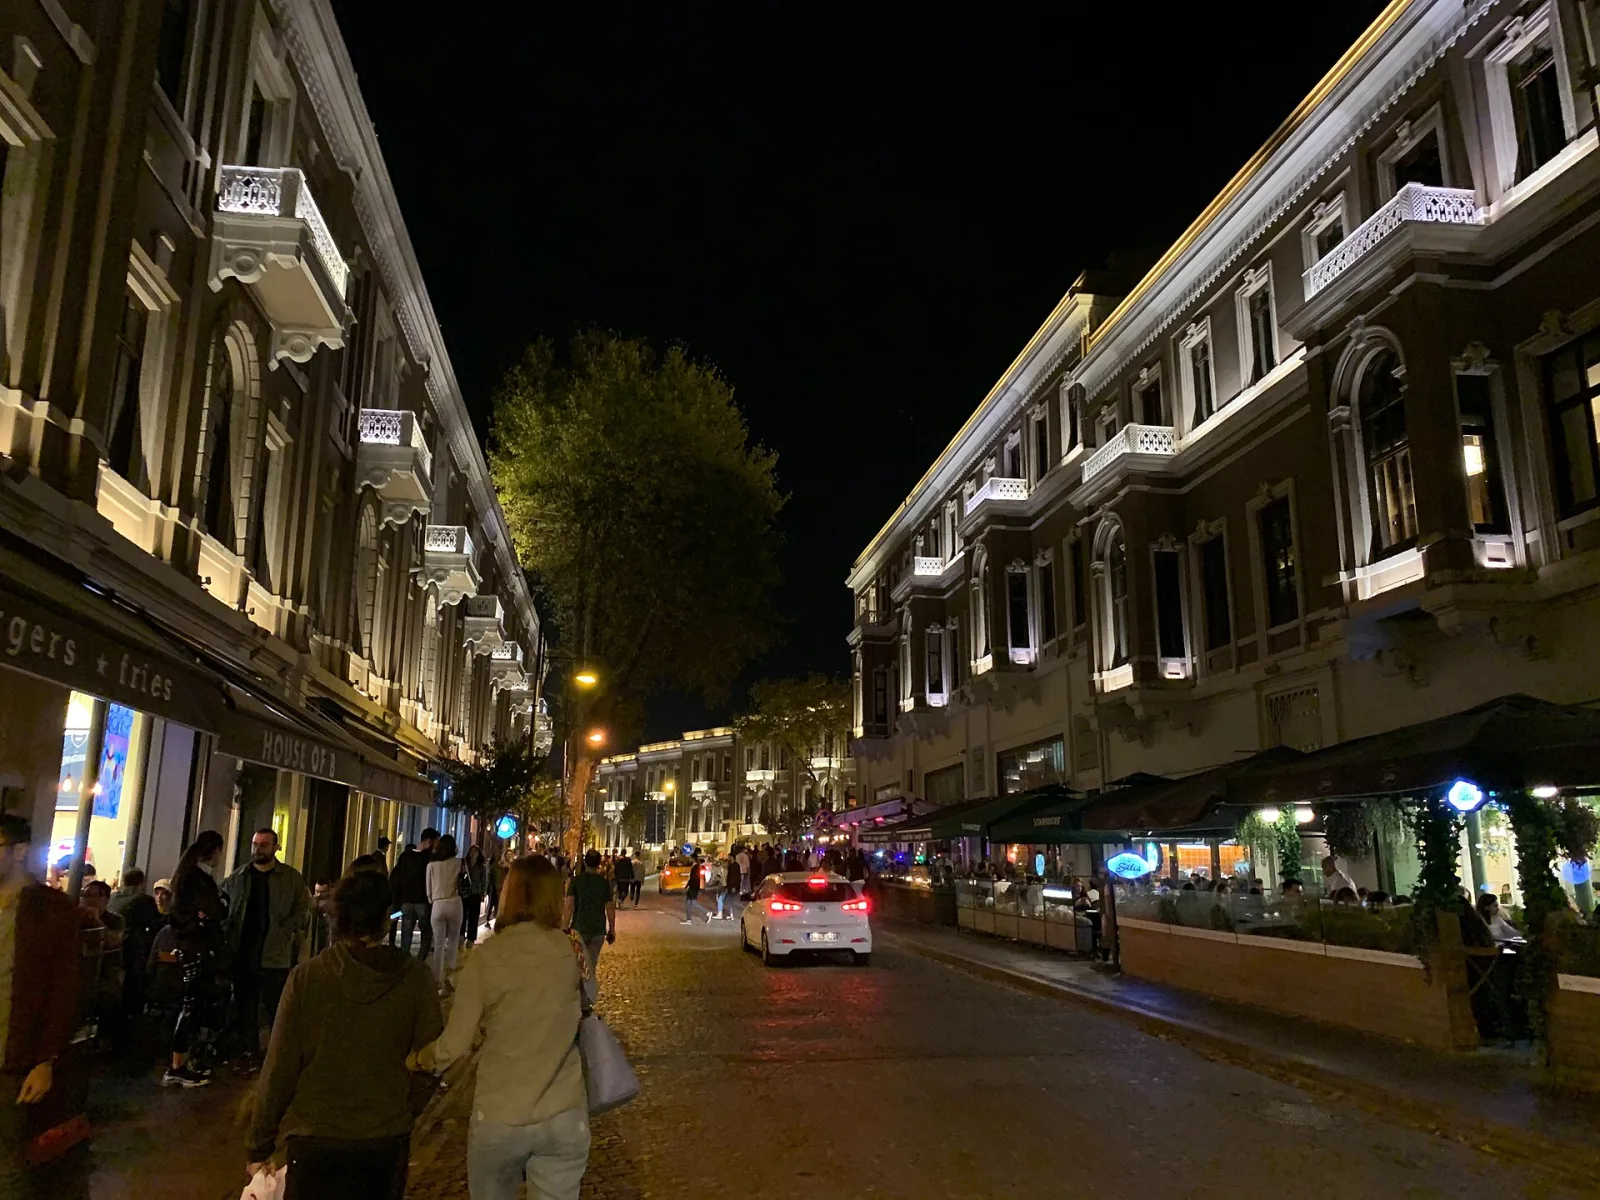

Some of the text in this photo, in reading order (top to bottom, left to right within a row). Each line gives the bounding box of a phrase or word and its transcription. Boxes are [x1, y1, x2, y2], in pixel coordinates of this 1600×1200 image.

[0, 610, 173, 701] gers fries
[261, 729, 307, 769] HOUSE
[311, 744, 327, 775] OF
